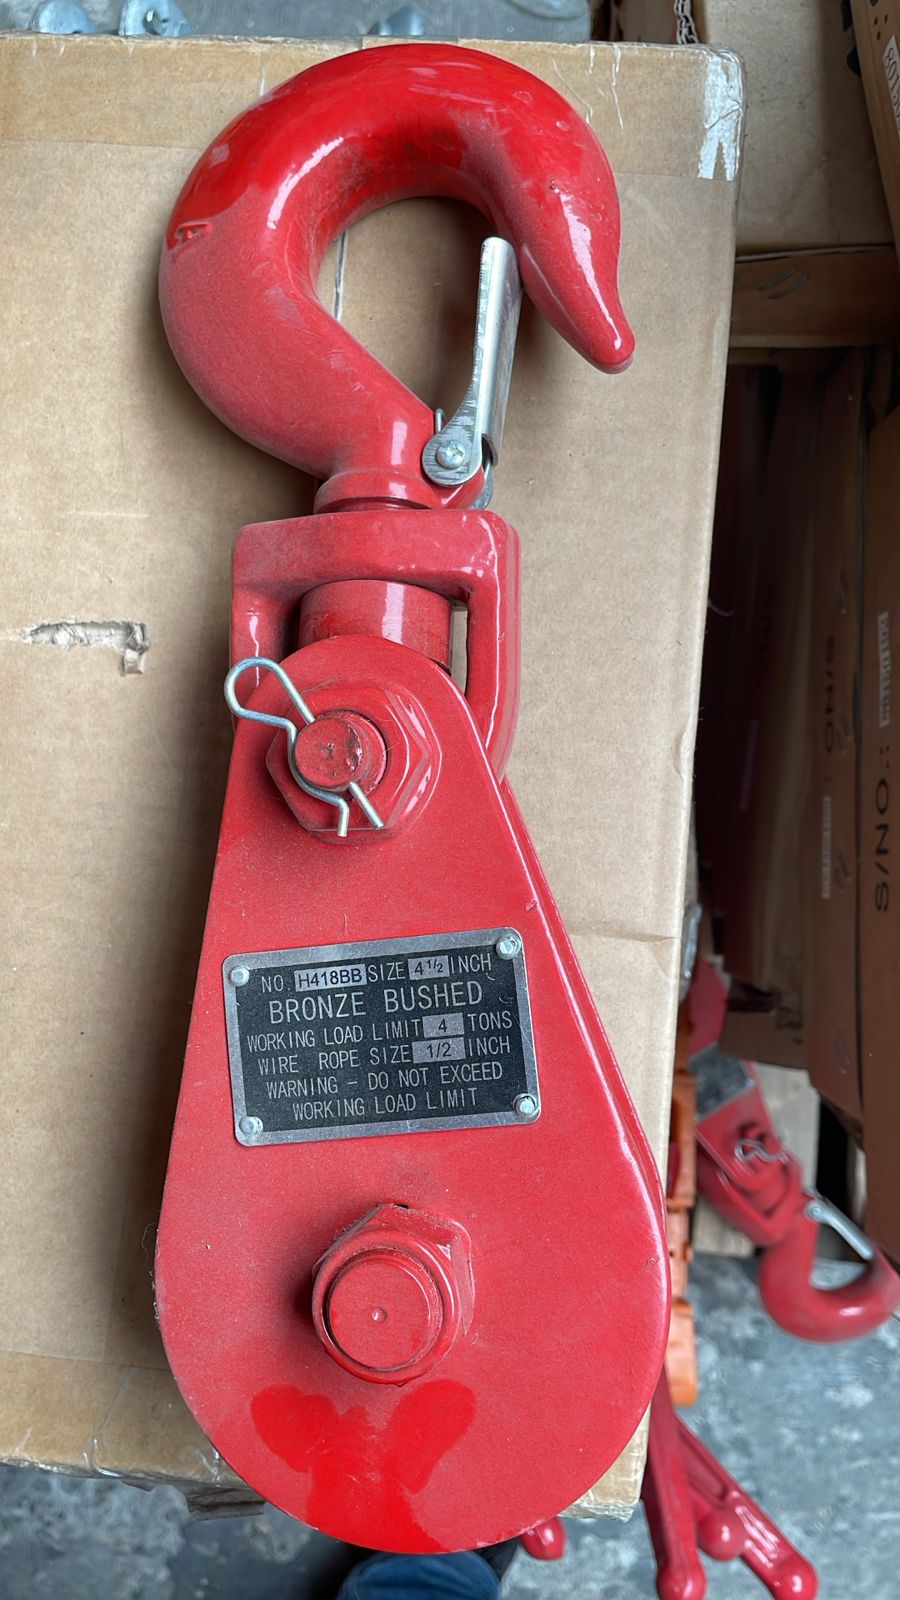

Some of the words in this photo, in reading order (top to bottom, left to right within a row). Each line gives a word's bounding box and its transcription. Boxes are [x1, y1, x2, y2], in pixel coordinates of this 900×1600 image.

[298, 968, 363, 988] H418BB
[368, 961, 406, 982] SIZE
[450, 953, 492, 974] INCH
[269, 992, 366, 1024] BRONZE
[384, 981, 483, 1013] BUSHED
[247, 1030, 315, 1053] WORKING
[324, 1025, 363, 1045] LOAD
[372, 1019, 421, 1041] LIMIT
[438, 1019, 447, 1033] 4
[467, 1011, 513, 1032] TONS
[258, 1055, 299, 1075] WIRE
[319, 1050, 360, 1070] ROPE
[370, 1044, 411, 1066] SIZE
[426, 1043, 452, 1058] 1/2
[468, 1036, 511, 1057] INCH
[266, 1077, 338, 1099] WARNING
[368, 1072, 389, 1090] DO
[398, 1068, 429, 1088] NOT
[440, 1061, 503, 1084] EXCEED
[293, 1098, 365, 1121] WORKING
[375, 1093, 416, 1114] LOAD
[426, 1088, 477, 1110] LIMIT
